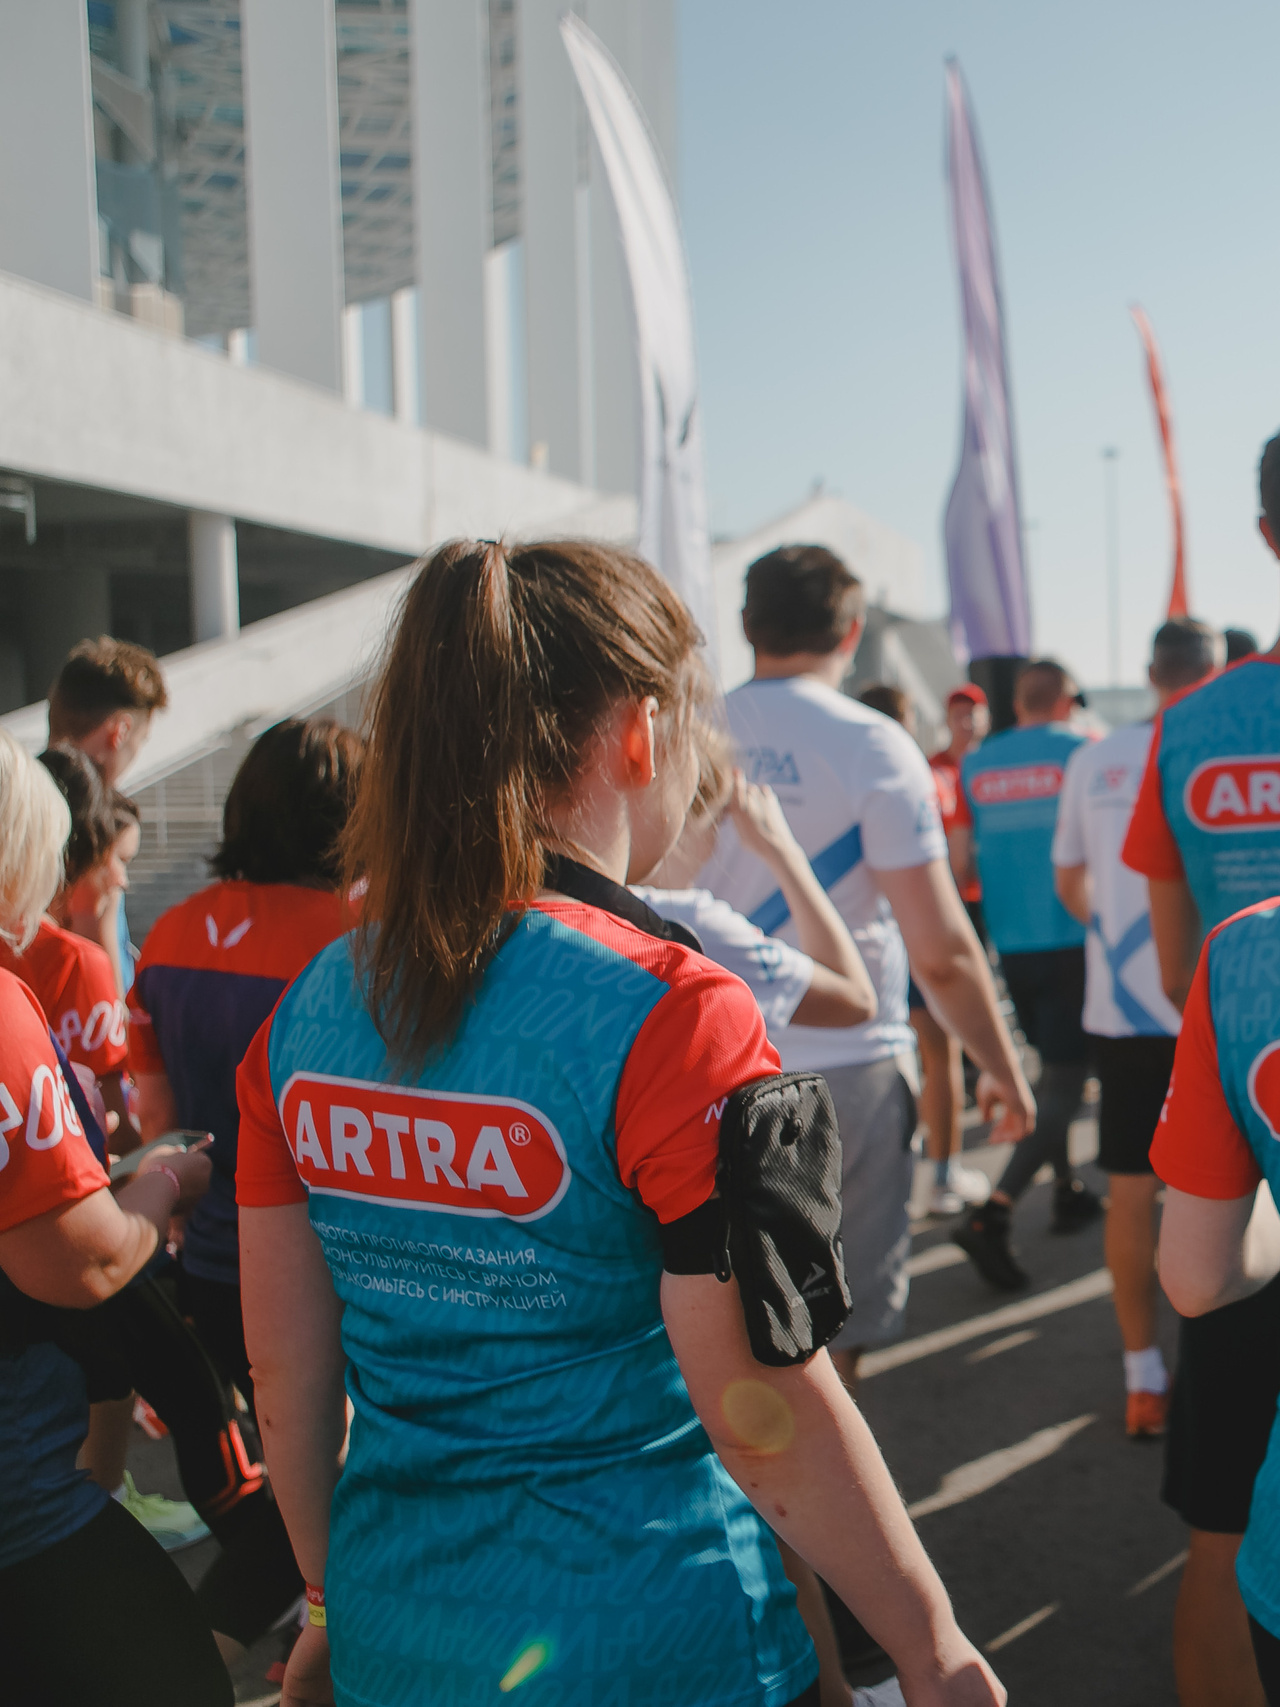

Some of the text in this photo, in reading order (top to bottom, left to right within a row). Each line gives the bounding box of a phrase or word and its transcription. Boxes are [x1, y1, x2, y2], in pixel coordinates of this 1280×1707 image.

[469, 1270, 480, 1284] С
[485, 1271, 558, 1288] ВРАЧОМ
[428, 1284, 440, 1301] С
[443, 1285, 568, 1311] ИНСТРУКЦИЕЙ
